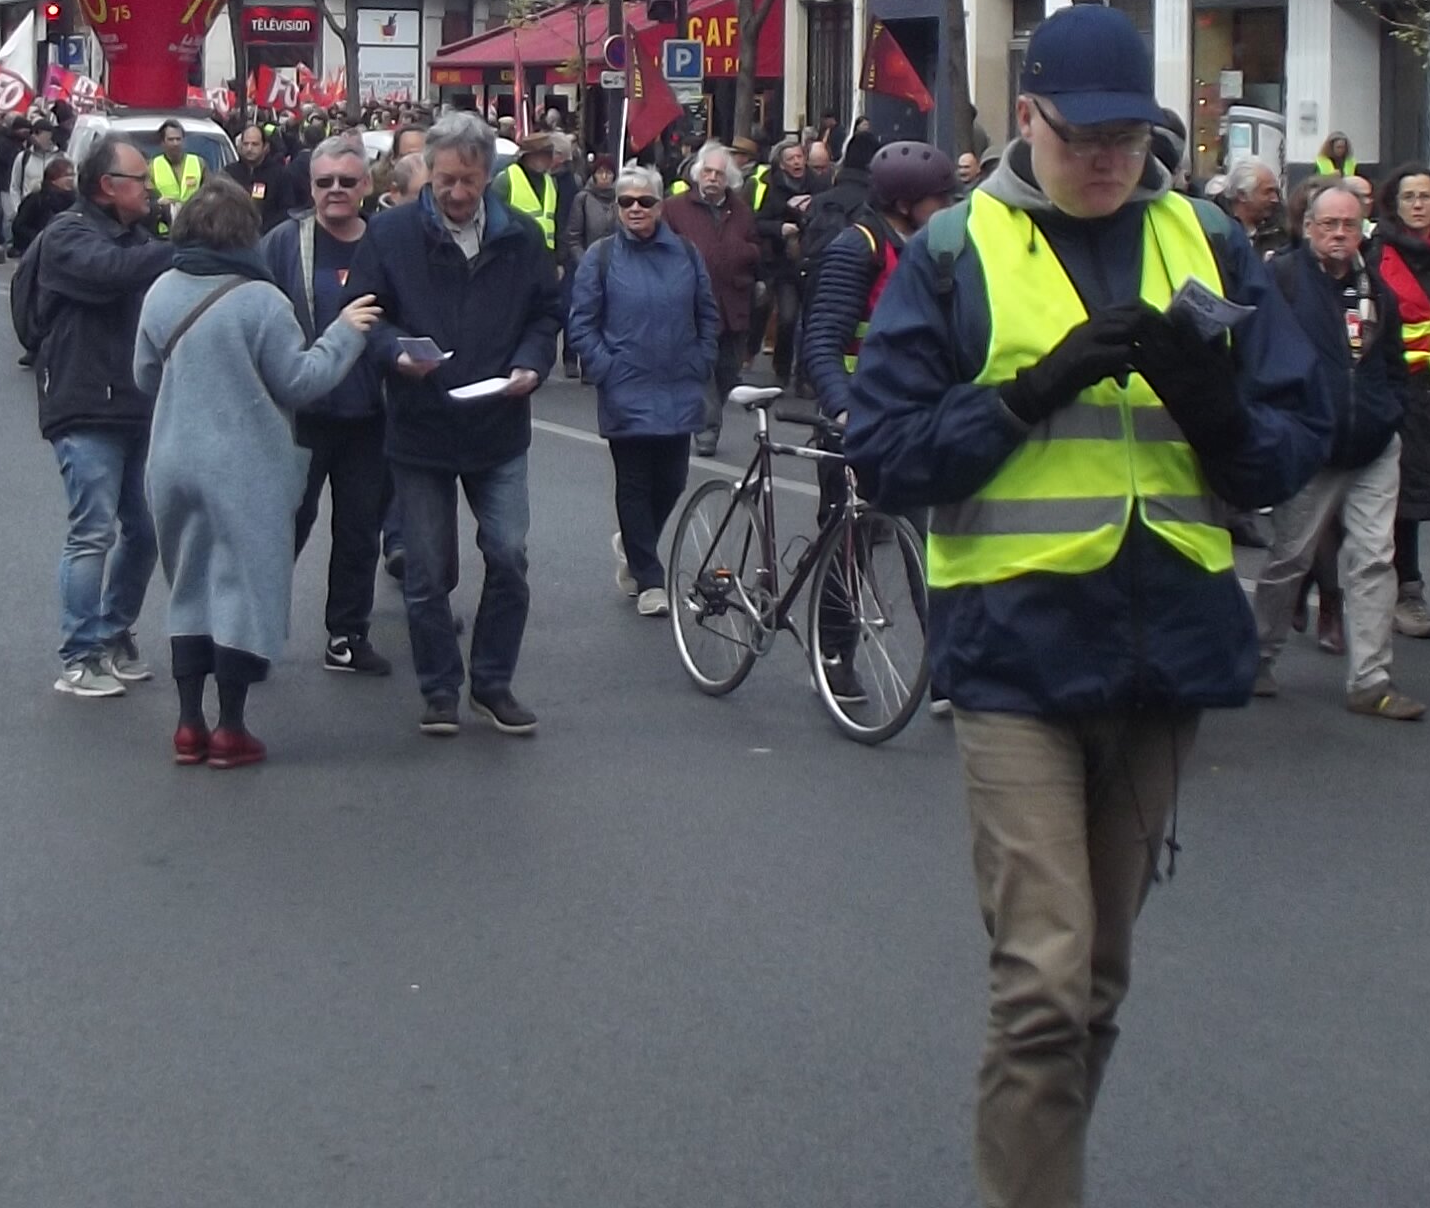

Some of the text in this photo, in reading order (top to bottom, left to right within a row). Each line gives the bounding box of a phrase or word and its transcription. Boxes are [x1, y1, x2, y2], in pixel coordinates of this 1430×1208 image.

[112, 5, 132, 23] 75
[688, 17, 739, 46] CAF
[675, 48, 692, 72] P
